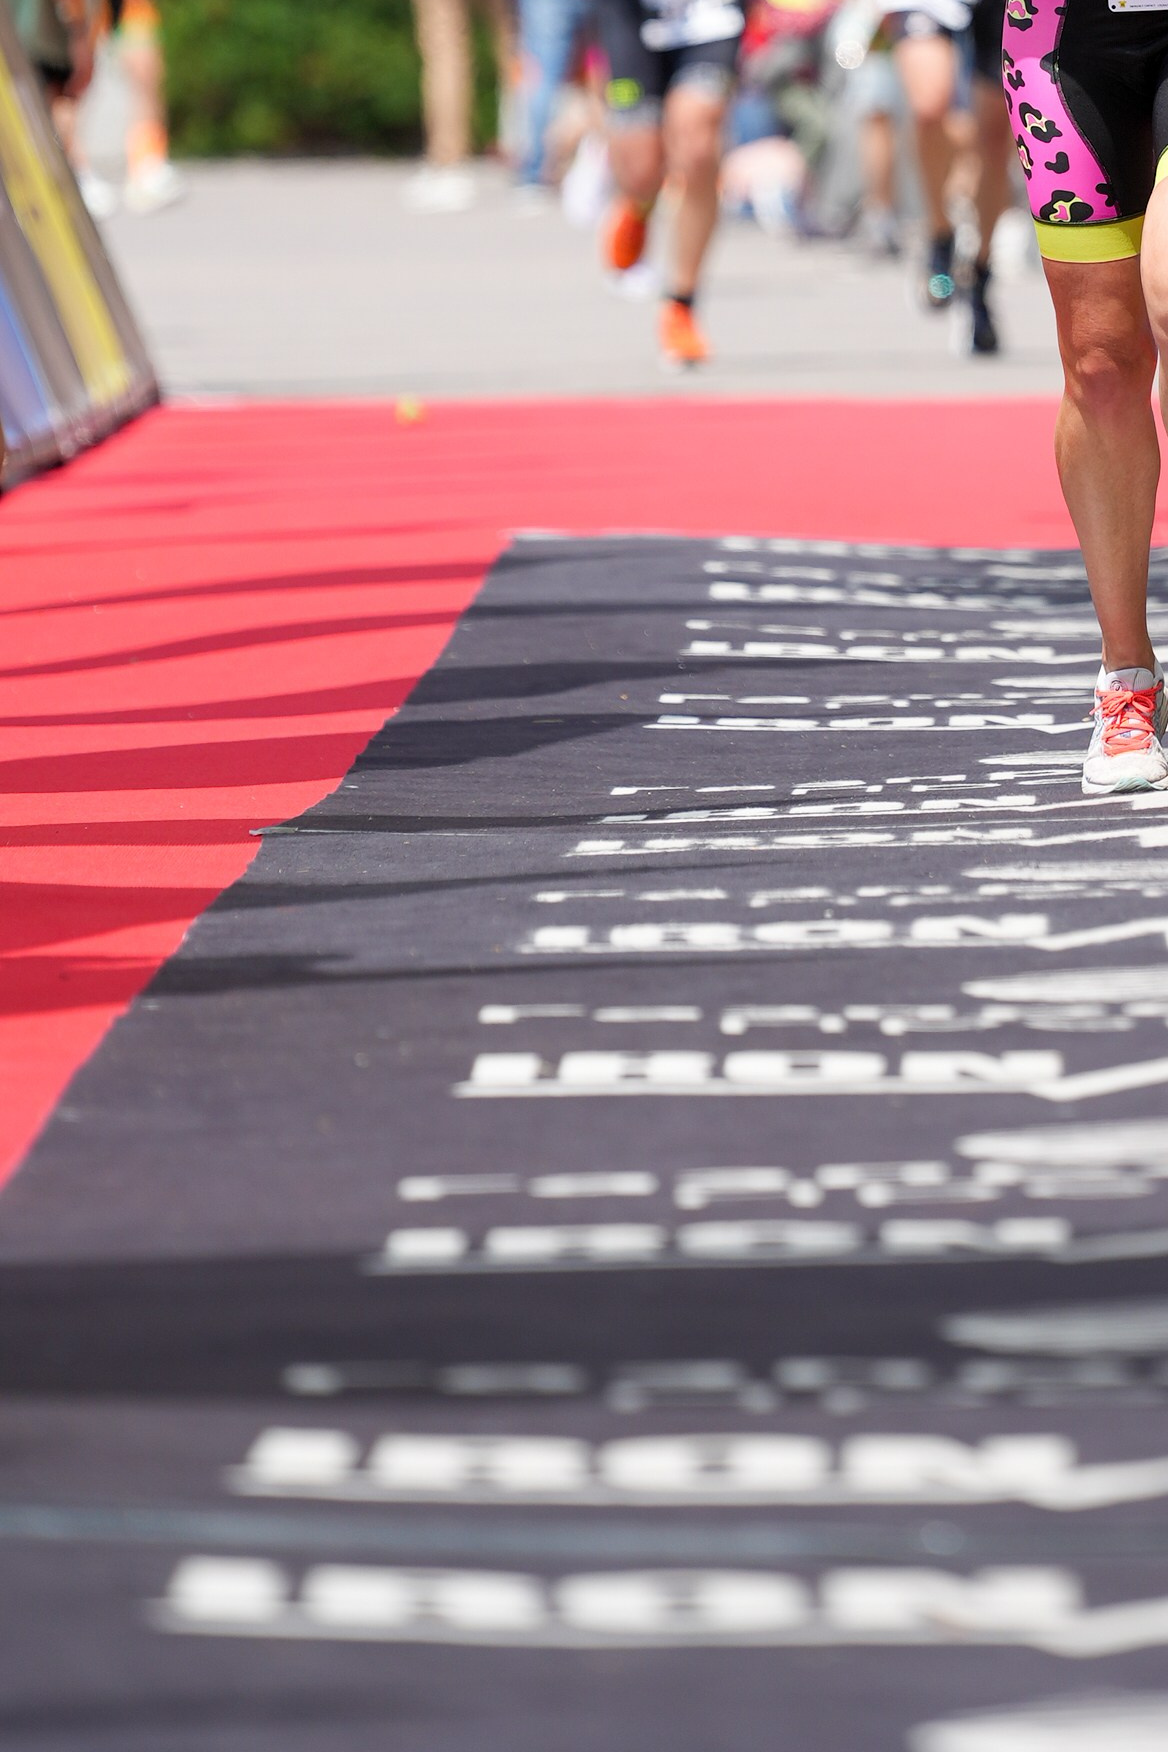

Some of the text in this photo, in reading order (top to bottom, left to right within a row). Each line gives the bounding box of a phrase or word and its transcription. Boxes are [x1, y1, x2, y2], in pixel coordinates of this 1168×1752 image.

[658, 714, 1054, 727] IRON
[602, 796, 1036, 822] IRON
[572, 828, 1034, 850] IRON
[534, 912, 1048, 947] IRON
[470, 1049, 1062, 1086] IRON
